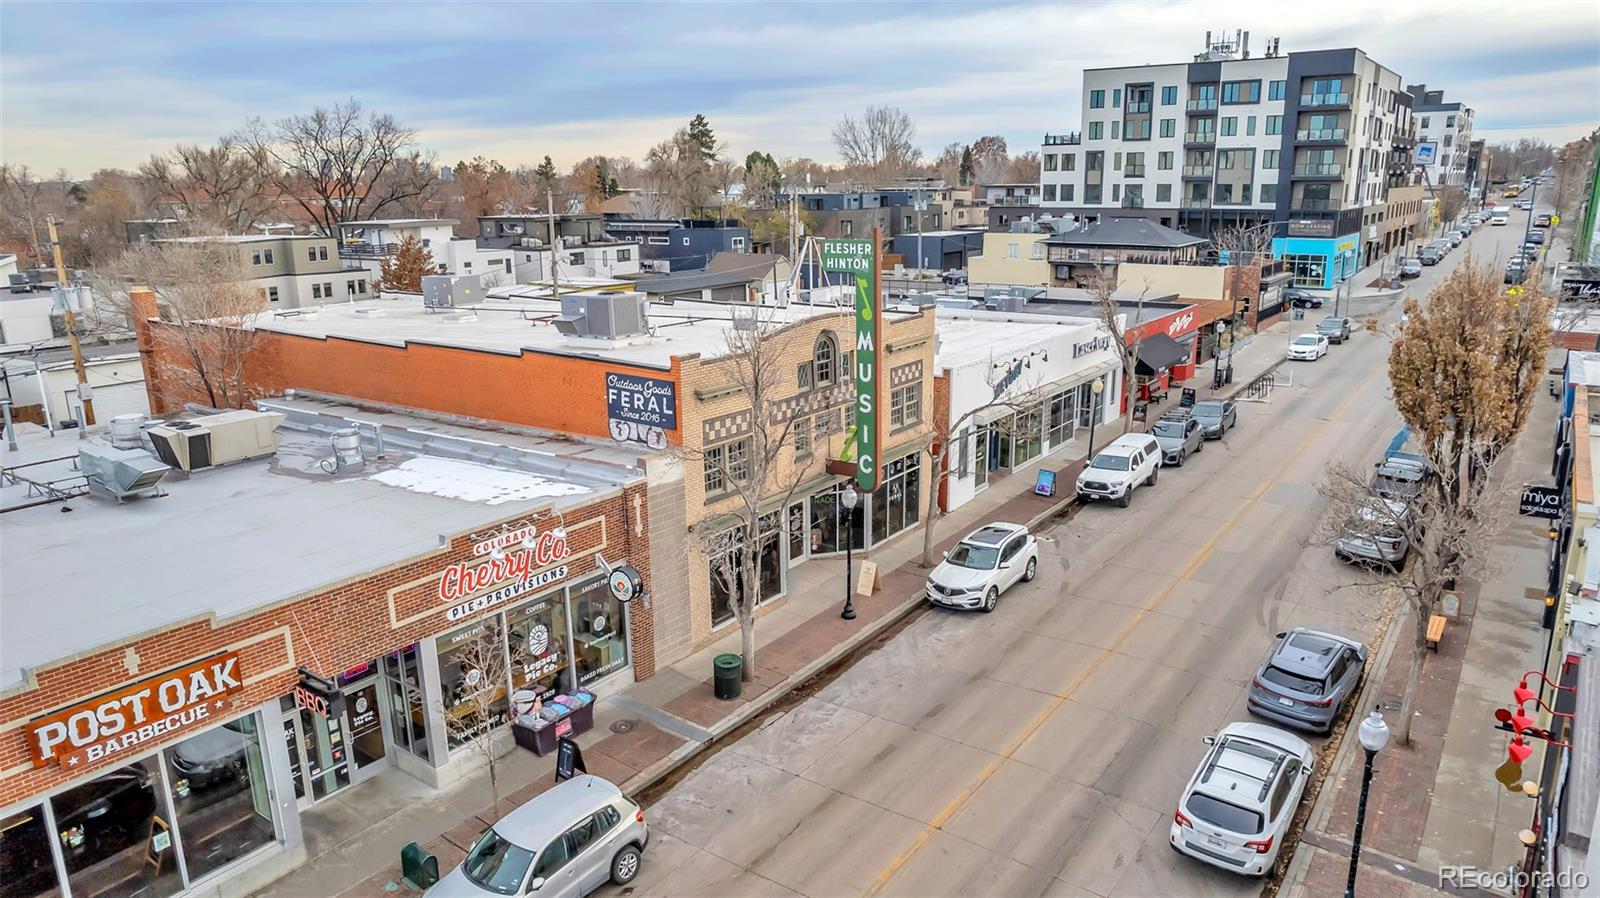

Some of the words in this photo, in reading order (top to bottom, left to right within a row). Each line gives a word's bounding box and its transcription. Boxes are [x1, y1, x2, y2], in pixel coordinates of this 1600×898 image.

[824, 243, 872, 255] FLESHER
[827, 257, 869, 269] HINTON
[608, 375, 644, 391] Outdoor
[644, 381, 671, 398] Goods
[608, 388, 673, 415] FERAL
[857, 330, 874, 474] MUSIC
[621, 408, 640, 420] Since
[640, 412, 660, 423] 2016
[1522, 491, 1559, 506] miya
[475, 528, 535, 554] COLORADO
[440, 548, 533, 600] Cherry
[537, 532, 570, 564] Co.
[525, 602, 546, 615] COFFEE
[524, 653, 558, 674] Legacy
[525, 670, 541, 682] Pie
[34, 689, 151, 761] POST
[158, 656, 241, 713] OAK
[296, 686, 327, 718] BBQ
[86, 703, 209, 763] BARBECUE
